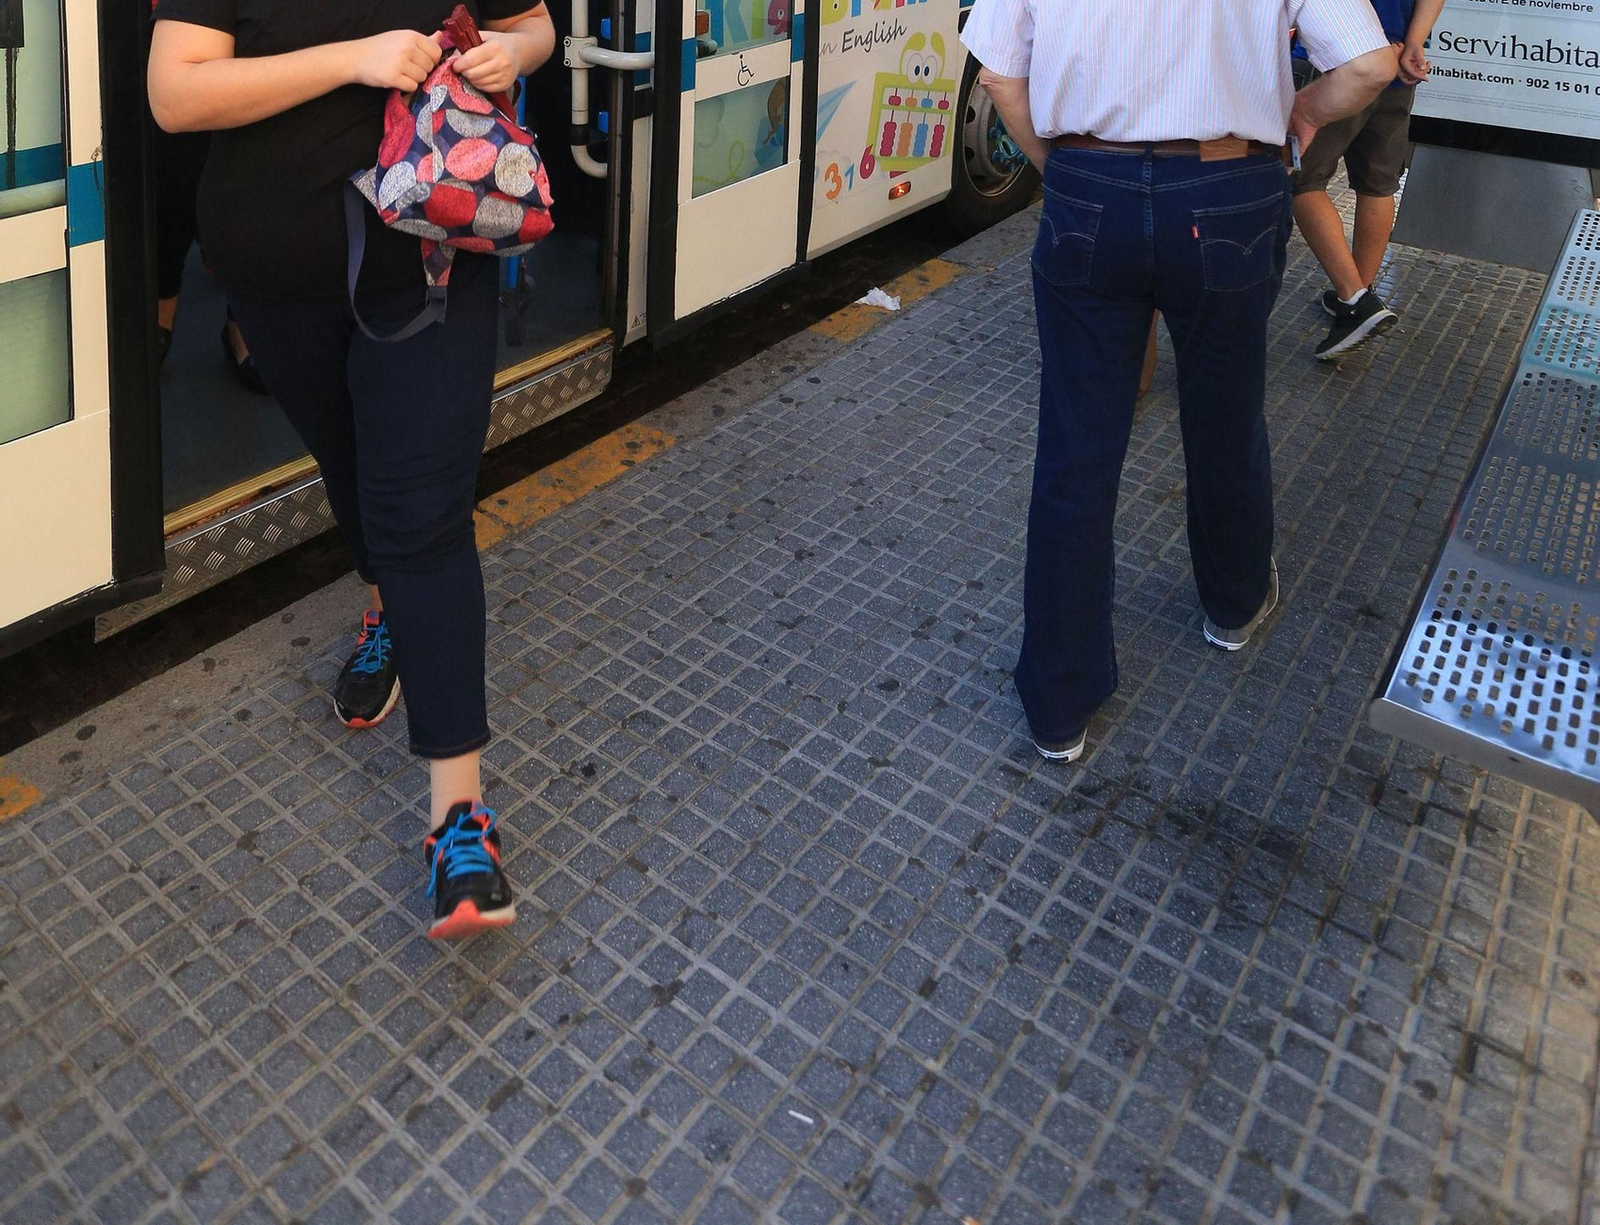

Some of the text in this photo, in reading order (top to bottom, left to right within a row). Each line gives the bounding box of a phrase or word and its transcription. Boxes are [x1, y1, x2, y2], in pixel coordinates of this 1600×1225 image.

[1529, 0, 1594, 13] noviembre
[842, 18, 907, 54] English
[1526, 77, 1550, 90] 902
[1554, 81, 1570, 92] 15
[1574, 83, 1590, 94] 01
